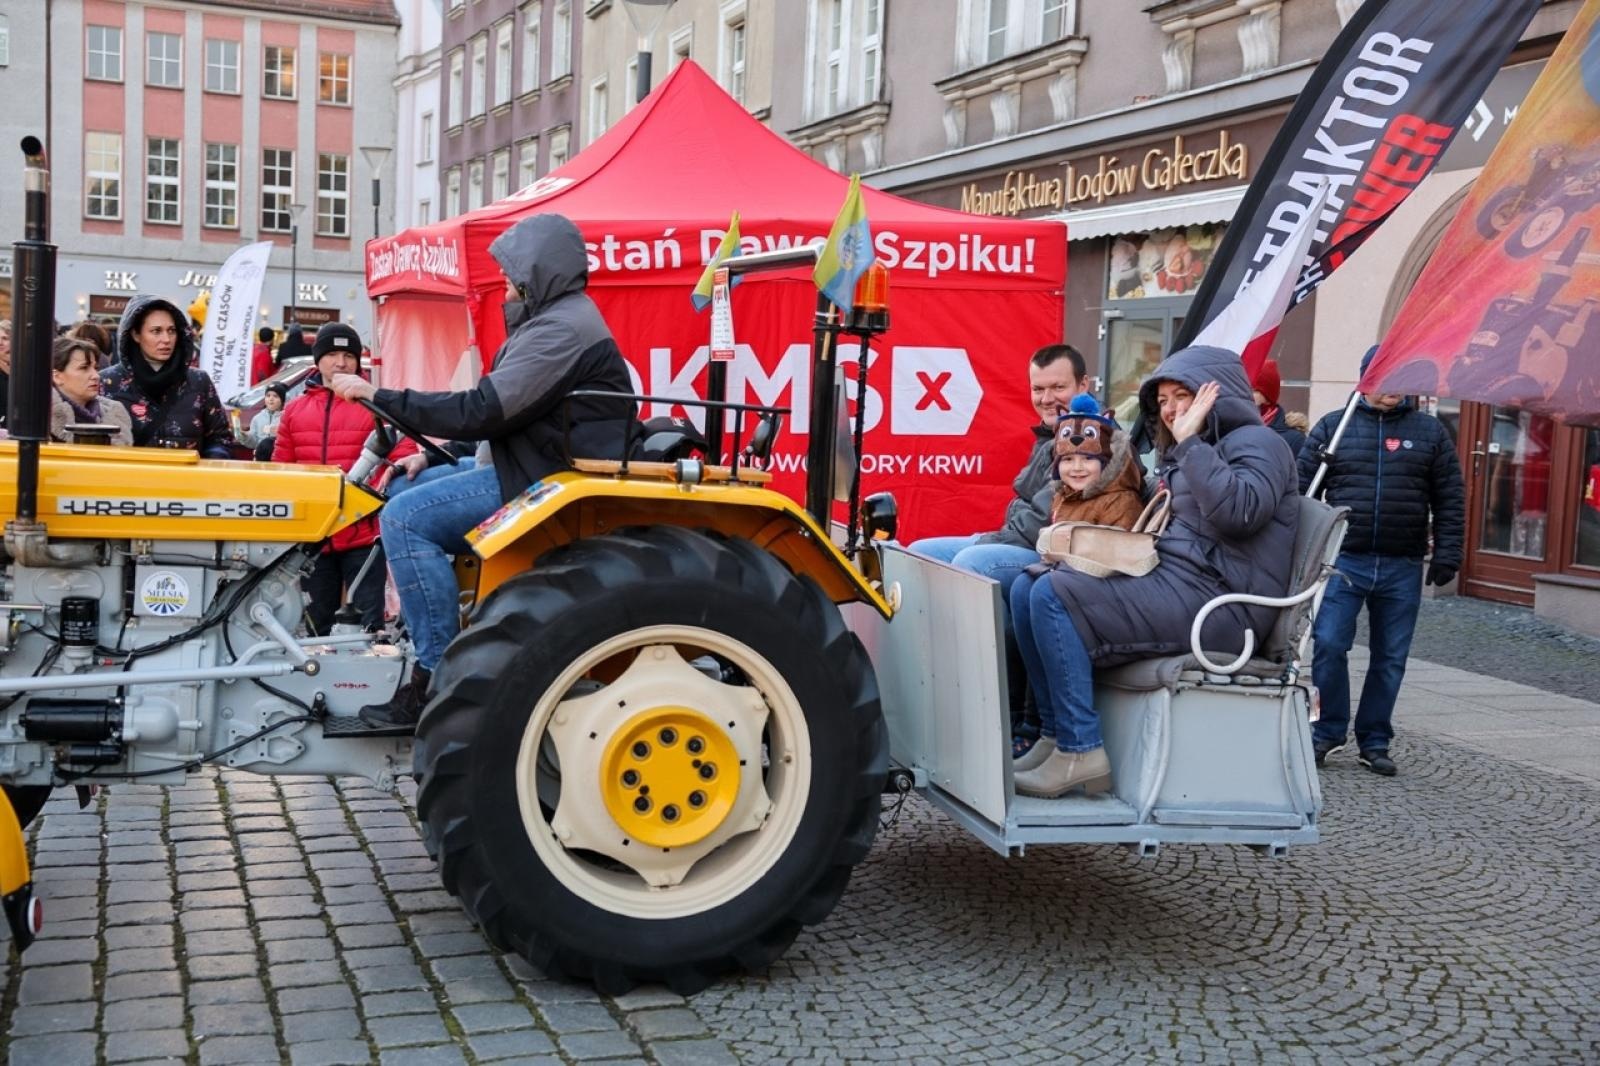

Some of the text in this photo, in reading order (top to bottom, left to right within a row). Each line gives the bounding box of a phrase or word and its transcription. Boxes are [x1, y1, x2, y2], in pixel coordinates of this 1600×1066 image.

[960, 130, 1247, 216] Manufaktura Lodów Gałeczka
[1329, 113, 1454, 268] OWER
[587, 228, 681, 272] stań
[874, 231, 1036, 278] Szpiku!
[178, 270, 218, 288] JUB
[216, 284, 233, 331] CZASÓW
[918, 454, 983, 475] KRWI
[64, 500, 289, 517] URSUS C-330
